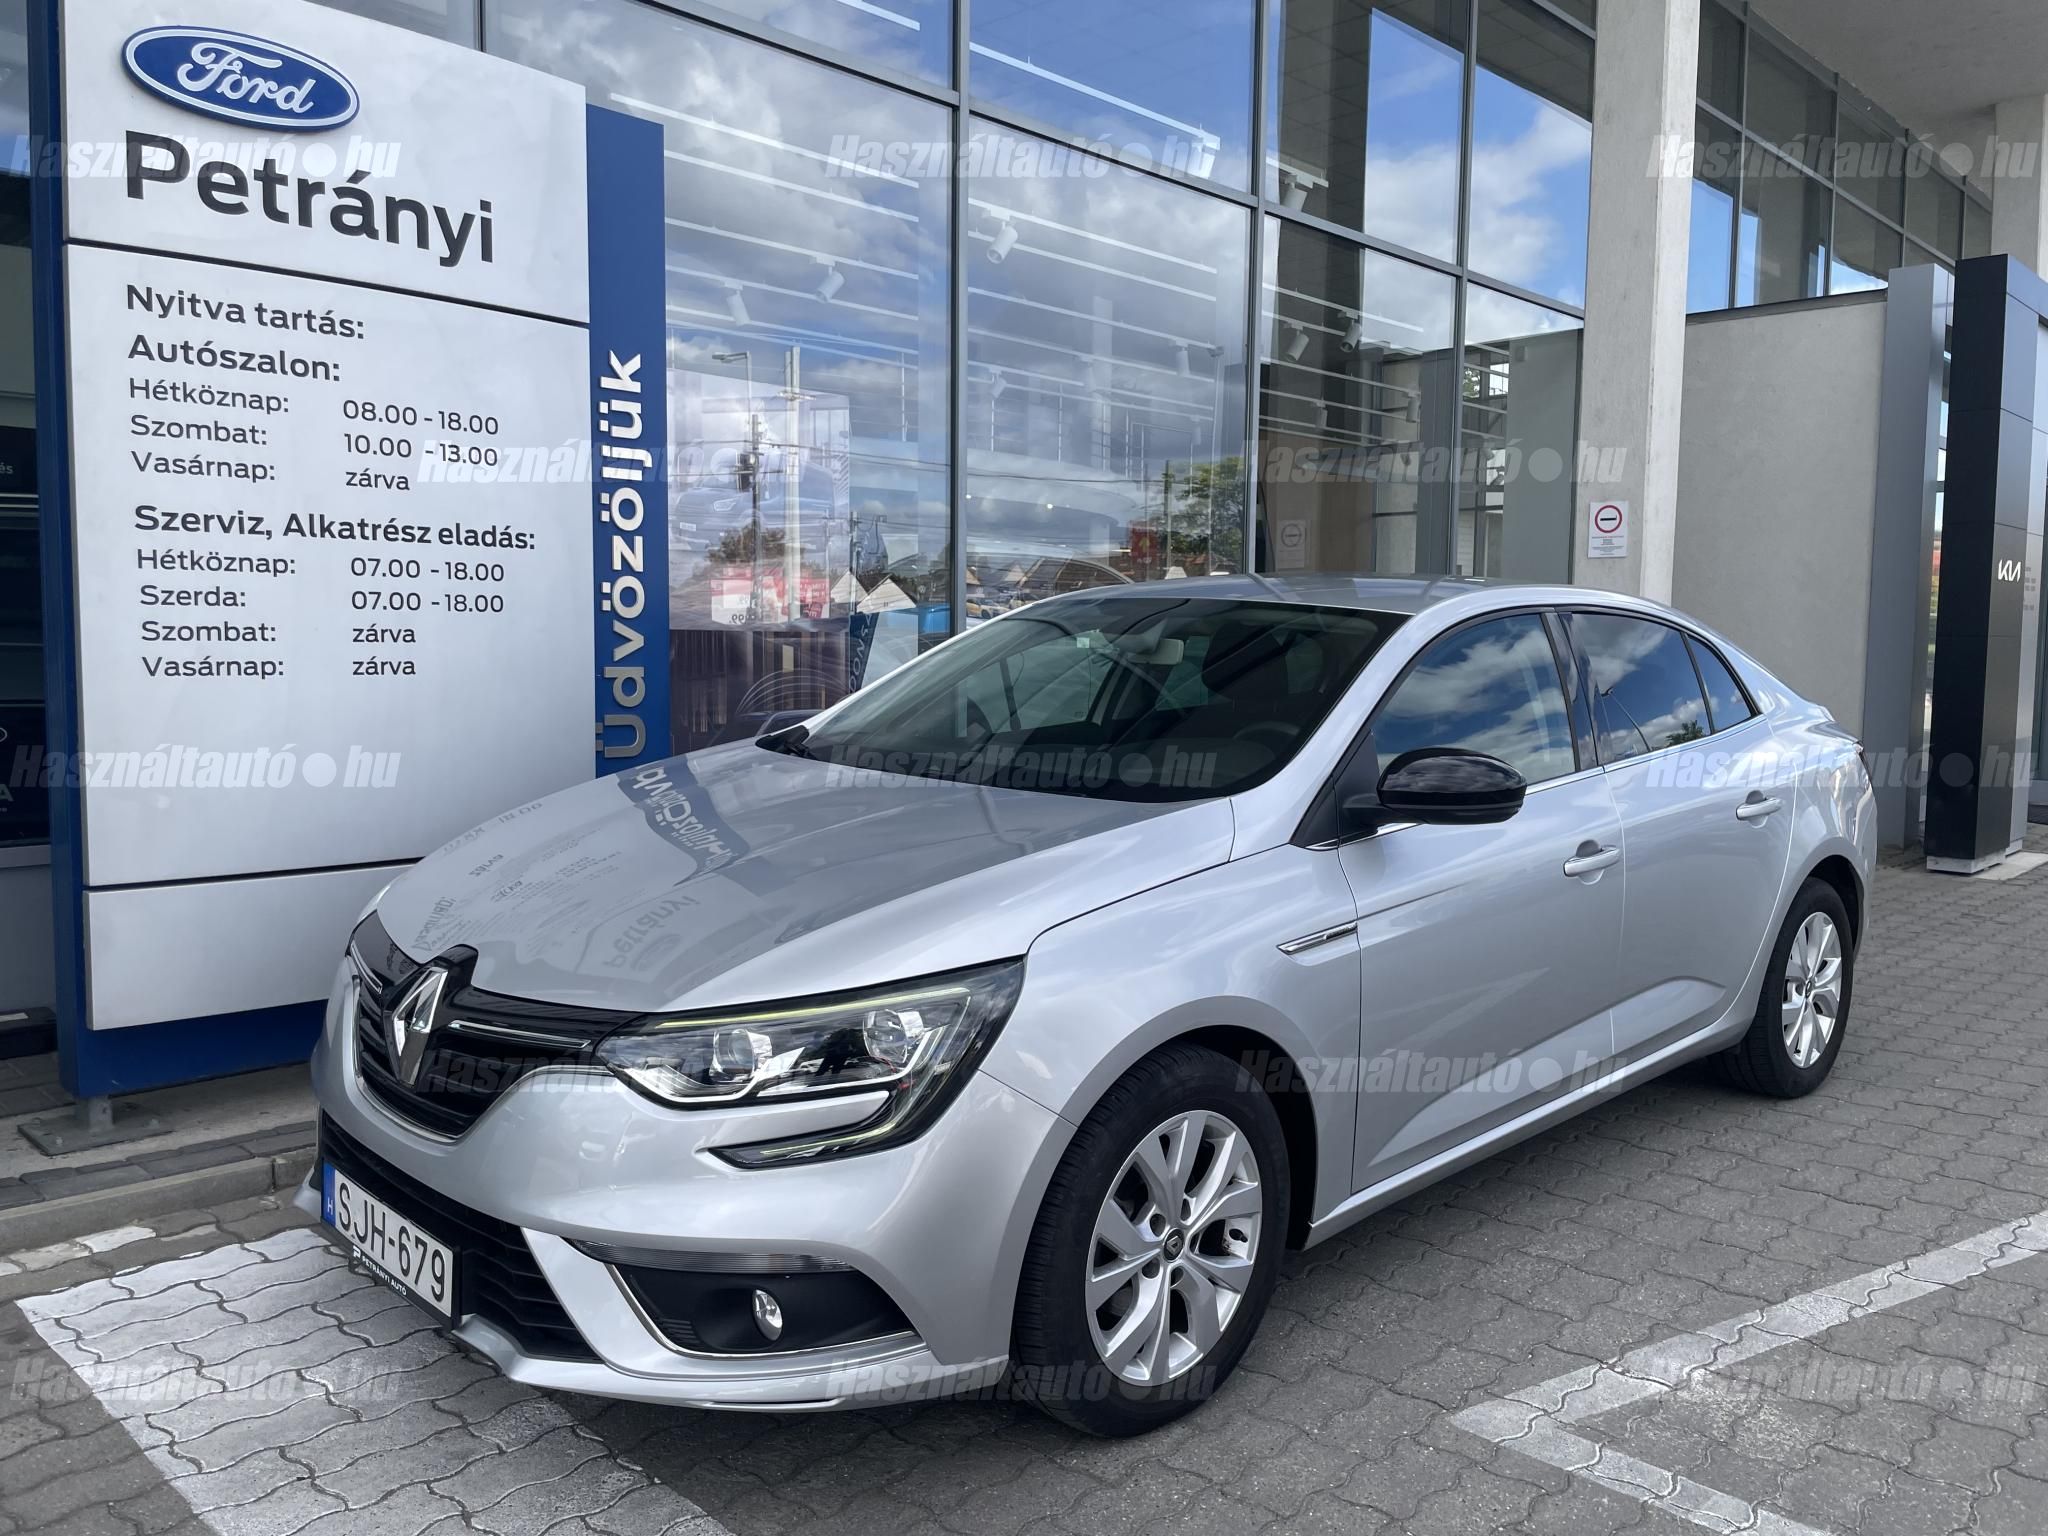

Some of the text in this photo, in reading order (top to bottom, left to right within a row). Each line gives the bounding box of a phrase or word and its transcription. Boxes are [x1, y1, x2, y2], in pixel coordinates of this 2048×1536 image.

[177, 42, 316, 113] Ford
[125, 129, 494, 268] Petrányi
[126, 284, 365, 340] Nyitva tartás:
[127, 334, 341, 382] Autószalon:
[129, 377, 290, 414] Hétköznap:
[342, 399, 418, 426] 08.00
[129, 414, 268, 446] Szombat:
[343, 432, 412, 459] 10.00
[130, 450, 276, 482] Vasárnap:
[345, 467, 410, 492] zárva
[134, 504, 537, 550] Szerviz, Alkatrész eladás:
[136, 548, 297, 578] Hétköznap:
[350, 557, 422, 580] 07.00
[596, 348, 652, 760] Üdvözöljük
[140, 584, 247, 608] Szerda:
[351, 590, 422, 612] 07.00
[140, 620, 278, 643] Szombat:
[352, 623, 417, 645] zárva
[141, 654, 285, 681] Vasárnap:
[352, 655, 417, 677] zárva
[338, 1182, 446, 1303] SJH-679
